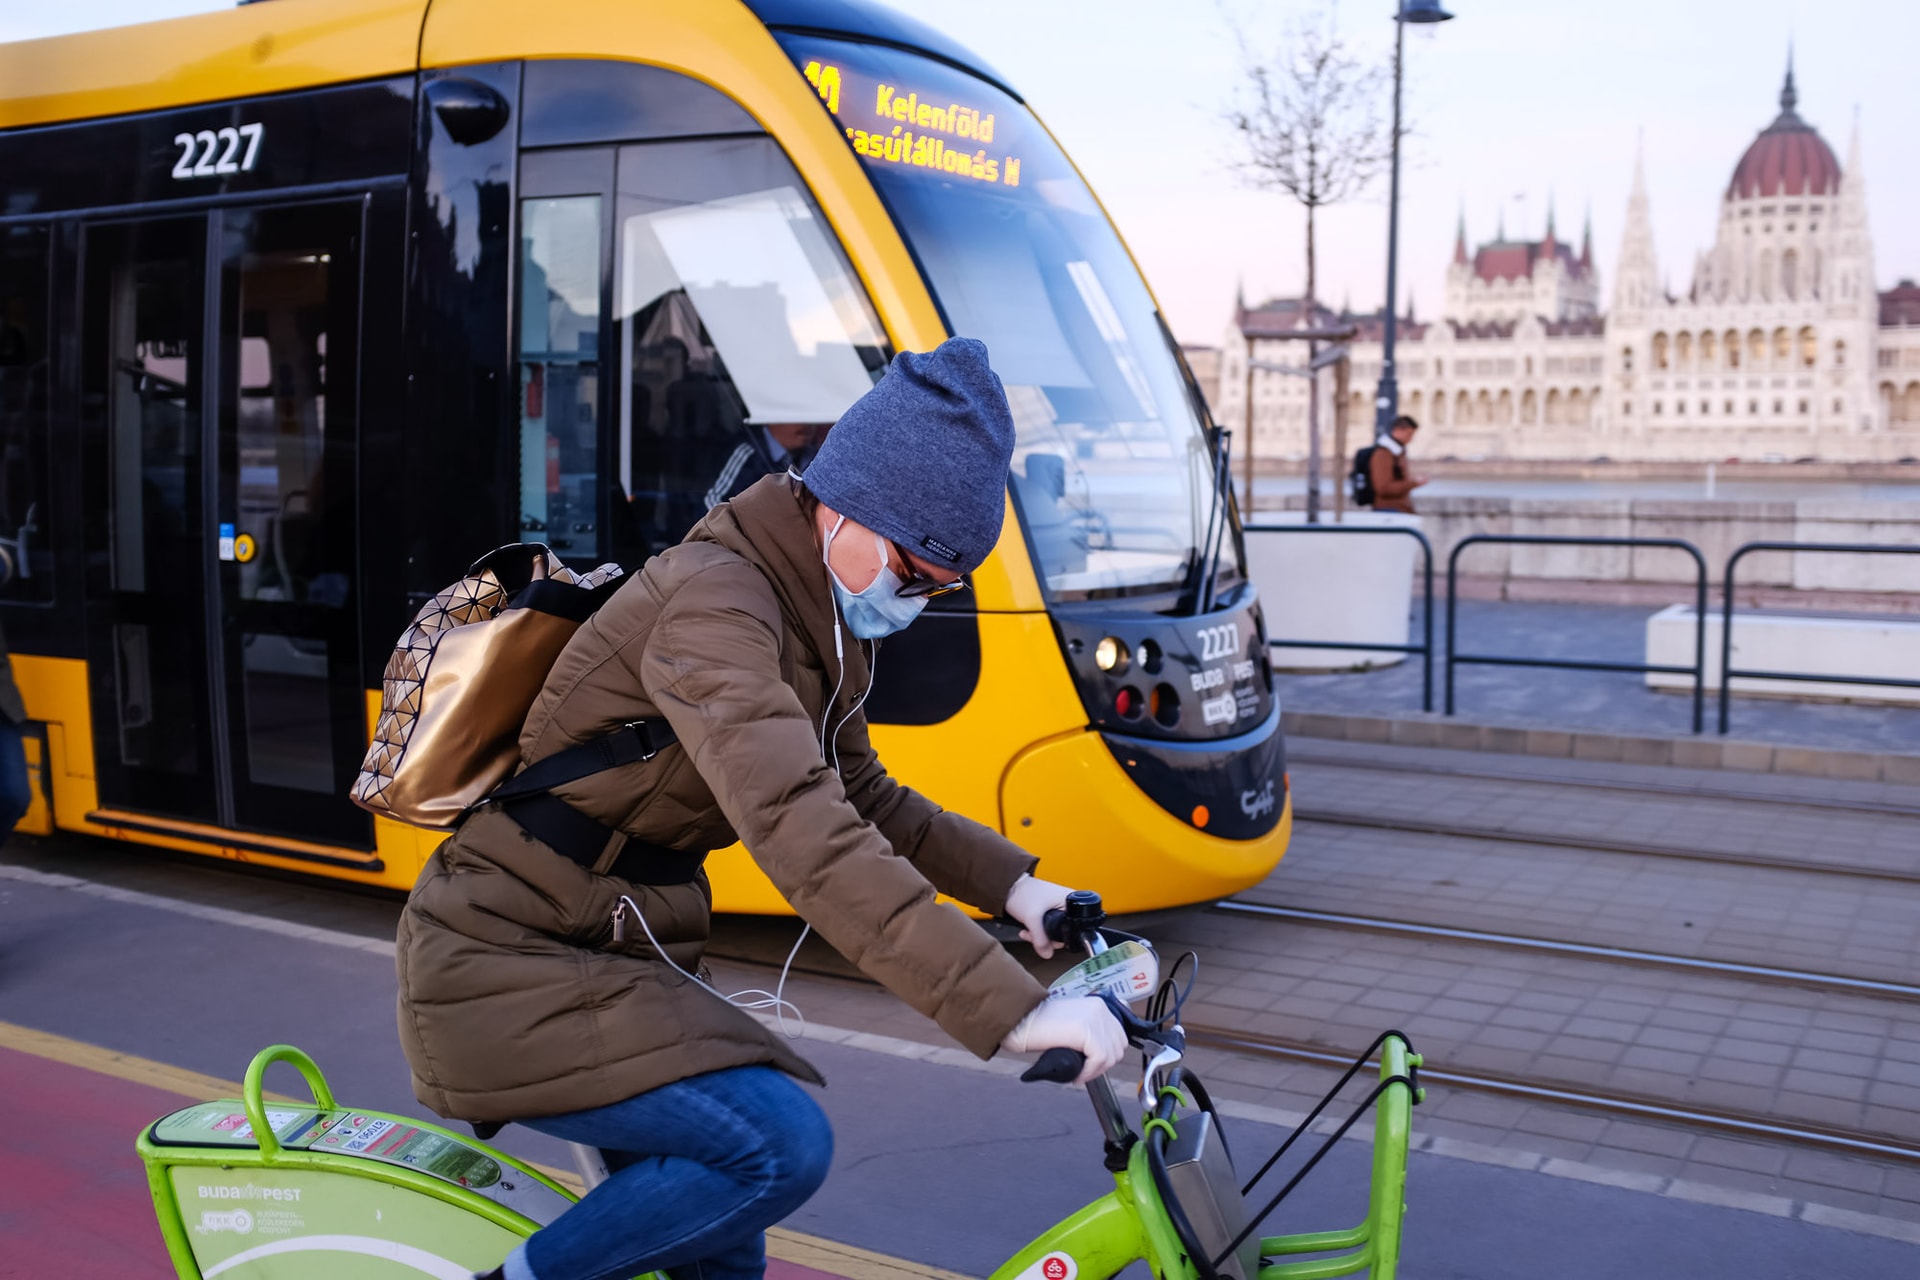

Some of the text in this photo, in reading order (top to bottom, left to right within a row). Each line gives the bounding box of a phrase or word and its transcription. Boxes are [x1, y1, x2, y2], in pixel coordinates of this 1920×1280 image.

[875, 83, 995, 144] Kelenföld
[171, 121, 264, 179] 2227
[1196, 622, 1239, 662] 2227
